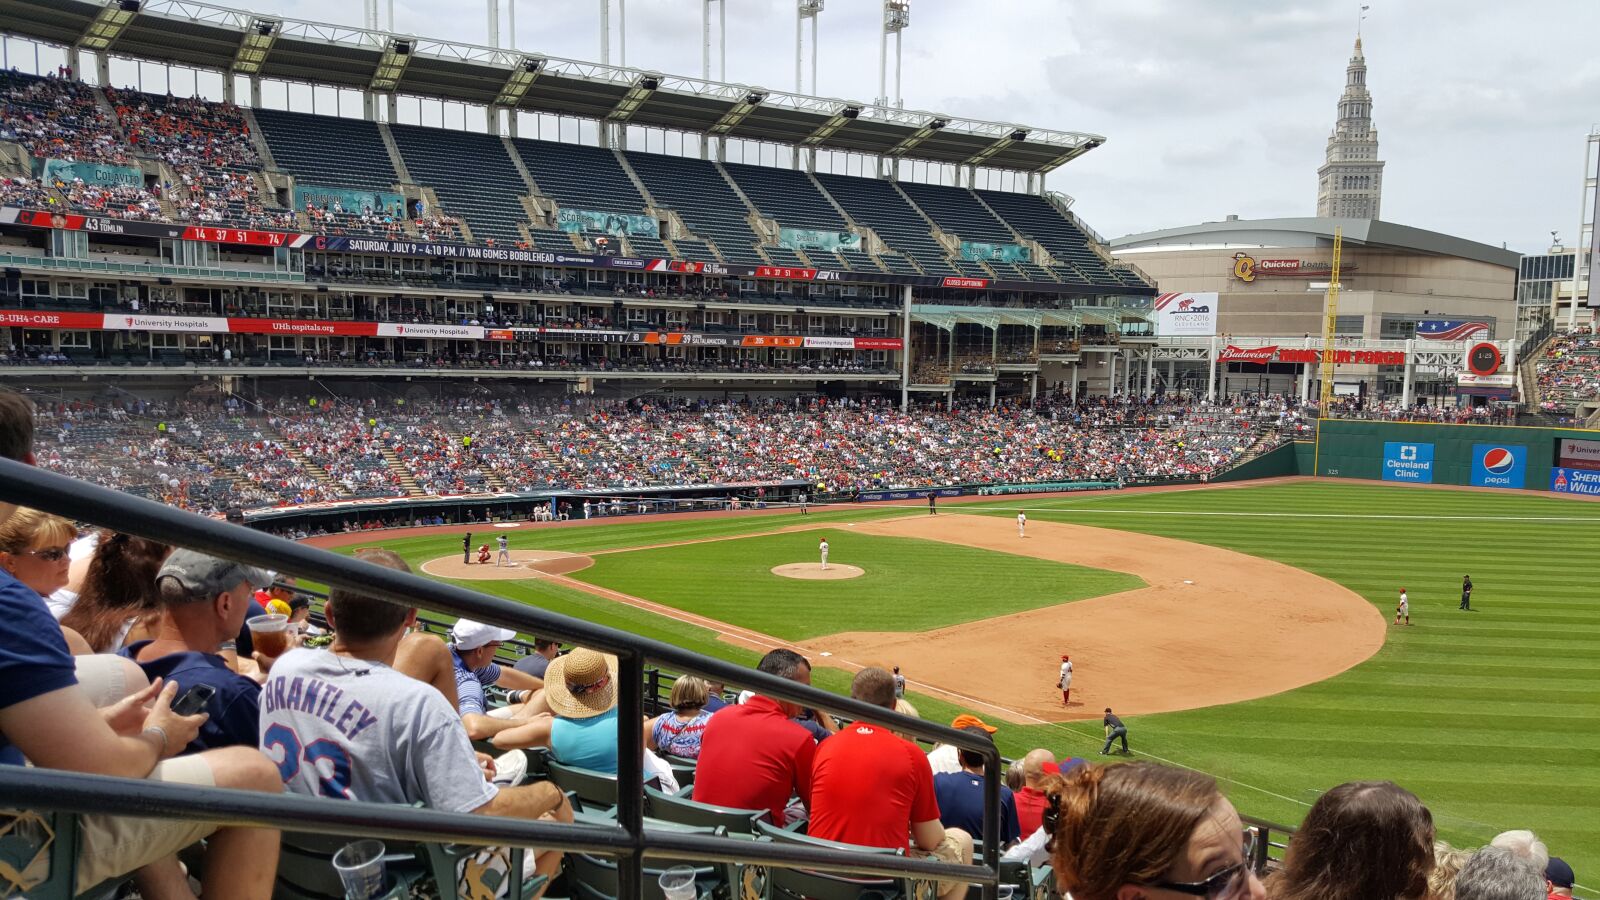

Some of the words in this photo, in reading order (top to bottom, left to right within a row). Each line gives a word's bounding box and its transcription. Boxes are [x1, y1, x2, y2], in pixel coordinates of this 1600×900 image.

[95, 169, 140, 186] COLAVITO
[85, 218, 99, 230] 43
[100, 224, 124, 233] TOMLIN
[195, 228, 206, 240] 14
[216, 229, 227, 241] 37
[237, 231, 247, 242] 51
[268, 233, 280, 244] 74
[349, 240, 390, 253] SATURDAY,
[392, 243, 411, 253] JULY
[411, 244, 417, 254] 9
[425, 245, 442, 256] 4:10
[444, 246, 458, 256] P.M.
[467, 248, 481, 258] YAN
[482, 248, 508, 260] GOMES
[509, 250, 555, 262] BOBBLEHEAD
[703, 263, 713, 273] 43
[1234, 256, 1256, 283] Q
[1262, 260, 1299, 269] Quicken
[1302, 260, 1329, 269] Loans
[134, 318, 172, 328] University
[174, 319, 209, 329] Hospitals
[404, 326, 438, 337] University
[439, 328, 469, 337] Hospitals
[1222, 348, 1273, 360] Budweiser
[1387, 460, 1430, 470] Cleveland
[1394, 469, 1420, 478] Clinic
[1571, 471, 1600, 483] SHER
[1484, 476, 1510, 485] pepsi
[266, 676, 378, 740] BRANTLEY
